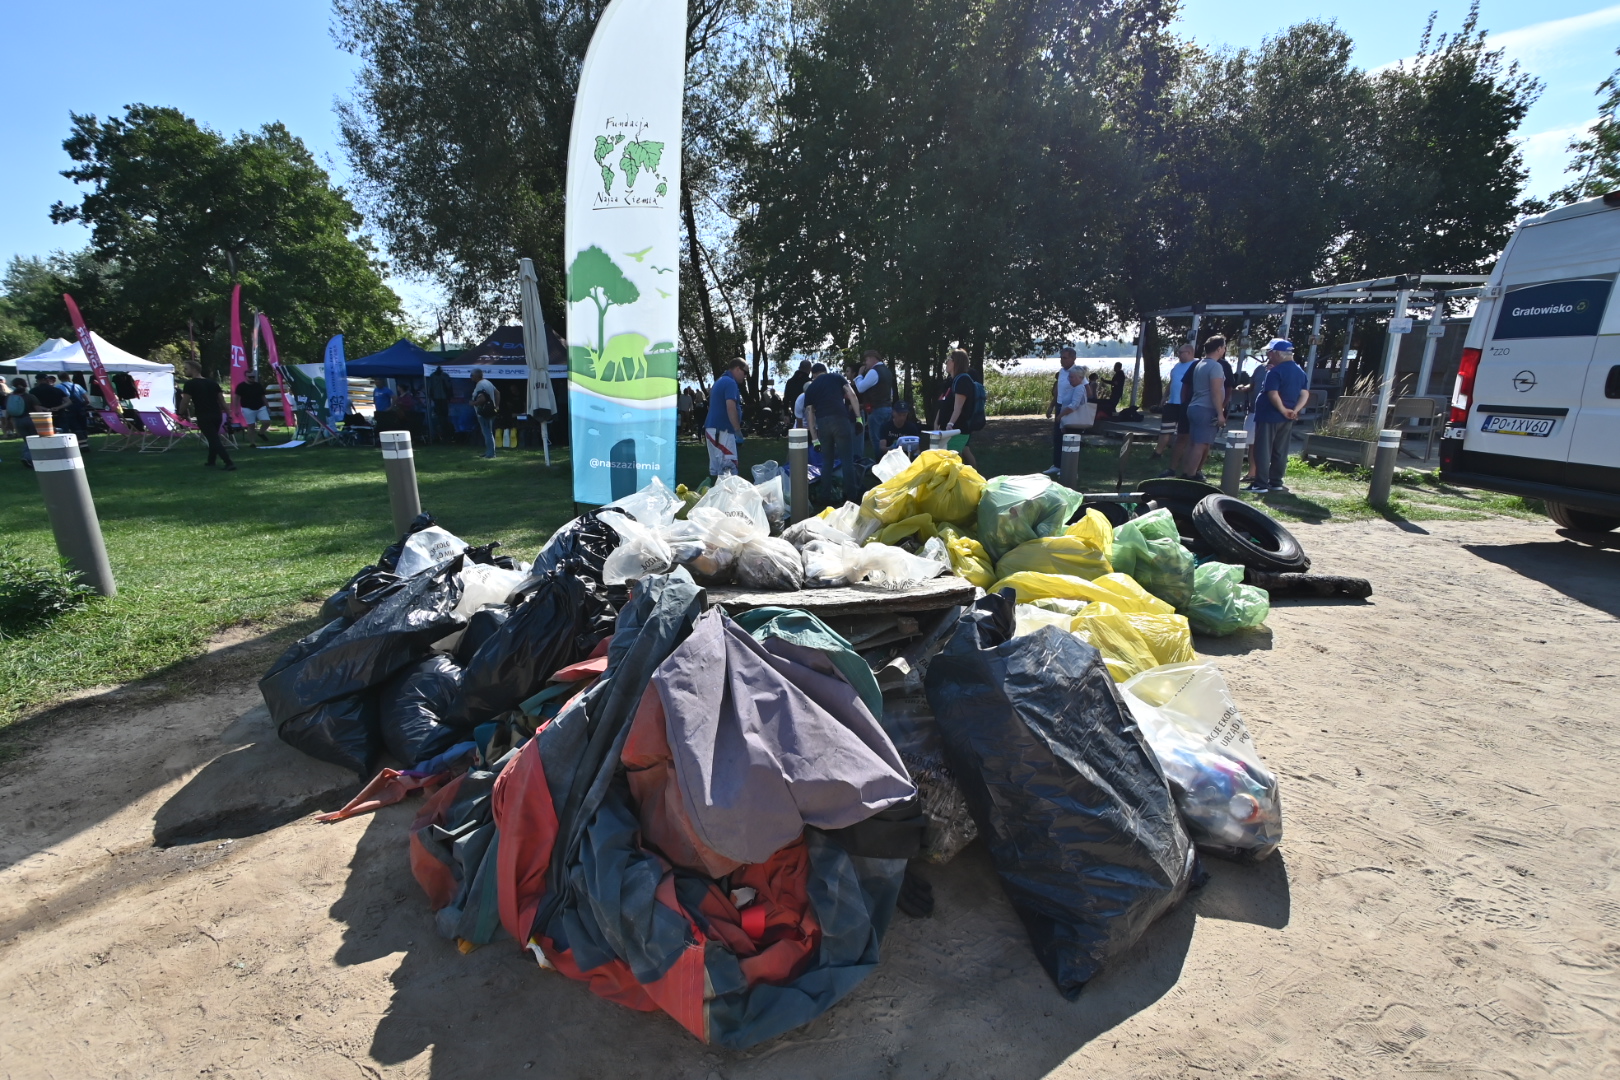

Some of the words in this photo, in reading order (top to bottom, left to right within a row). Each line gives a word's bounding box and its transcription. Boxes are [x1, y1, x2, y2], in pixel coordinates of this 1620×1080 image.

[605, 113, 649, 136] Fundacja
[1512, 303, 1573, 317] Gratowisko
[589, 457, 660, 470] @naszaziemia
